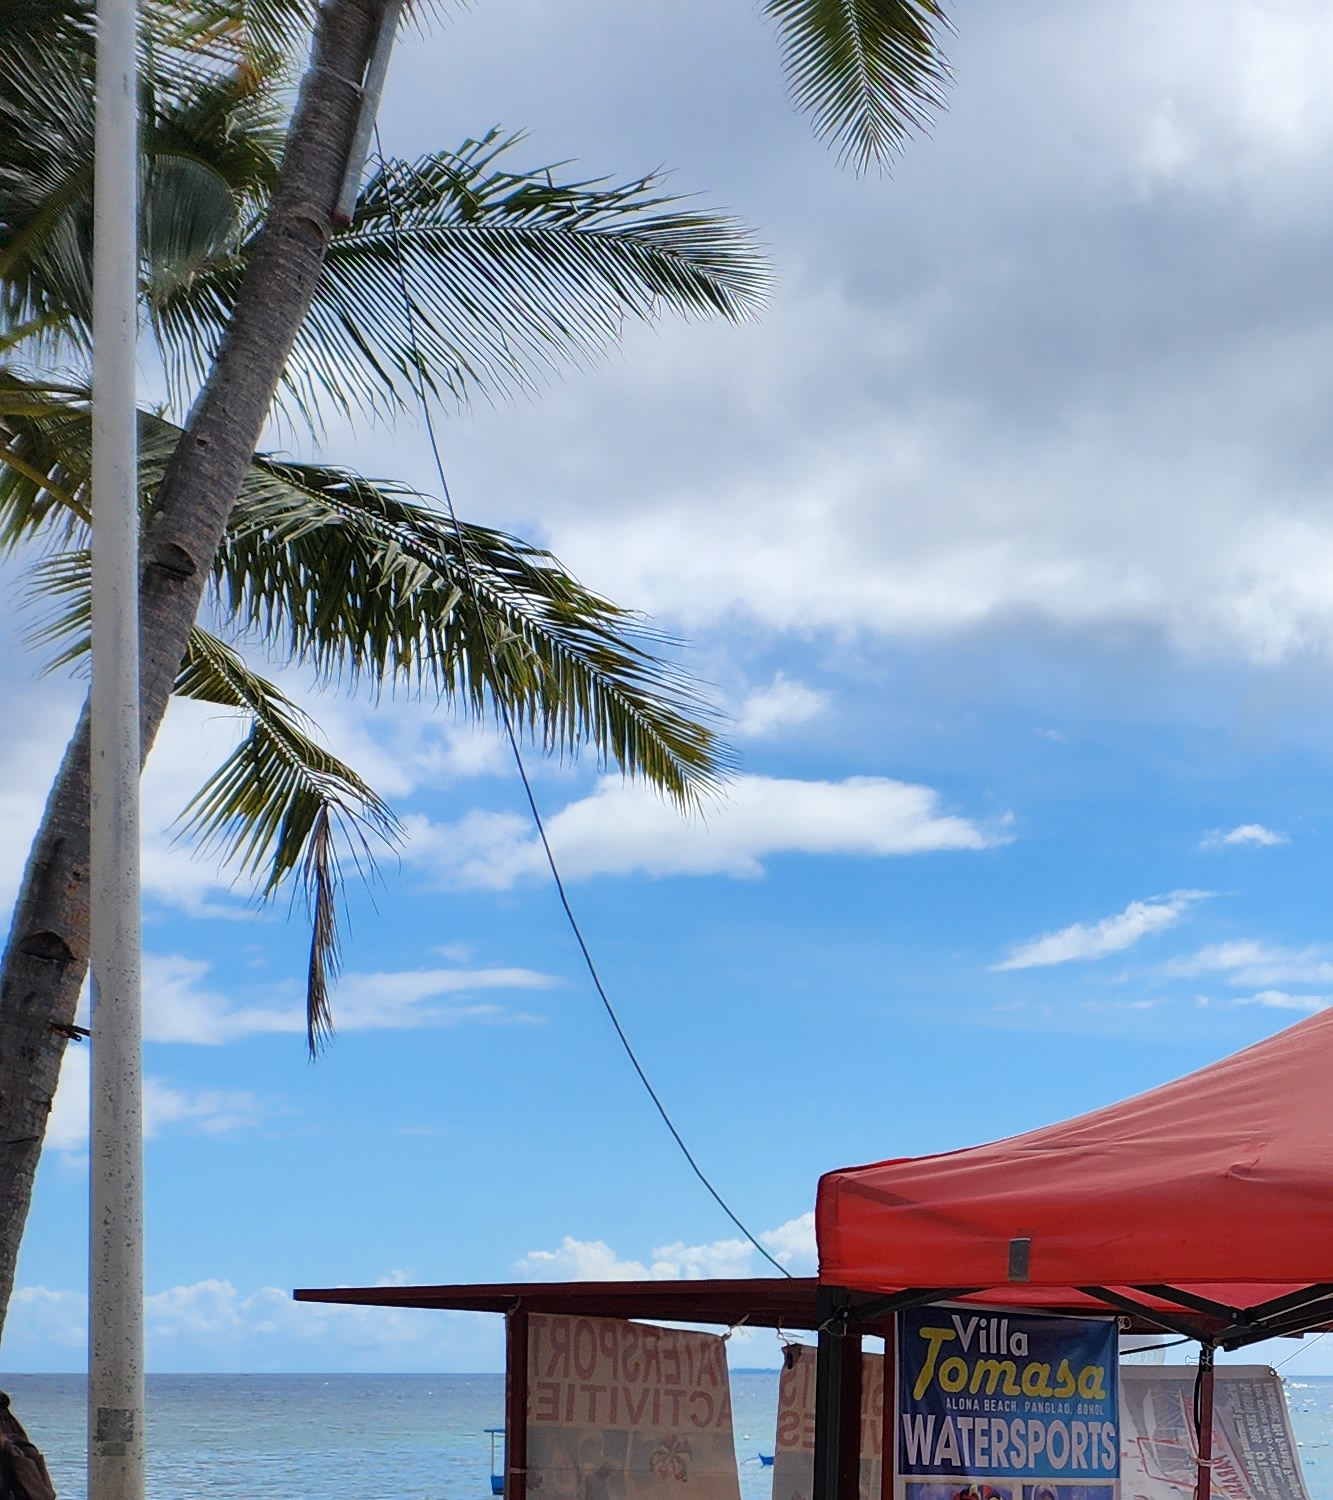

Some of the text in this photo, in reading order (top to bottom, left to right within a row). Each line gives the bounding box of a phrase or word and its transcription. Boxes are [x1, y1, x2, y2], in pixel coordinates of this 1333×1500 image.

[952, 1315, 1028, 1356] Villa
[913, 1327, 1106, 1400] Tomasa
[946, 1398, 979, 1411] ALONA
[1025, 1402, 1073, 1415] PANGLAO,
[1078, 1403, 1104, 1416] BOHOL
[902, 1413, 1117, 1471] WATERSPORTS
